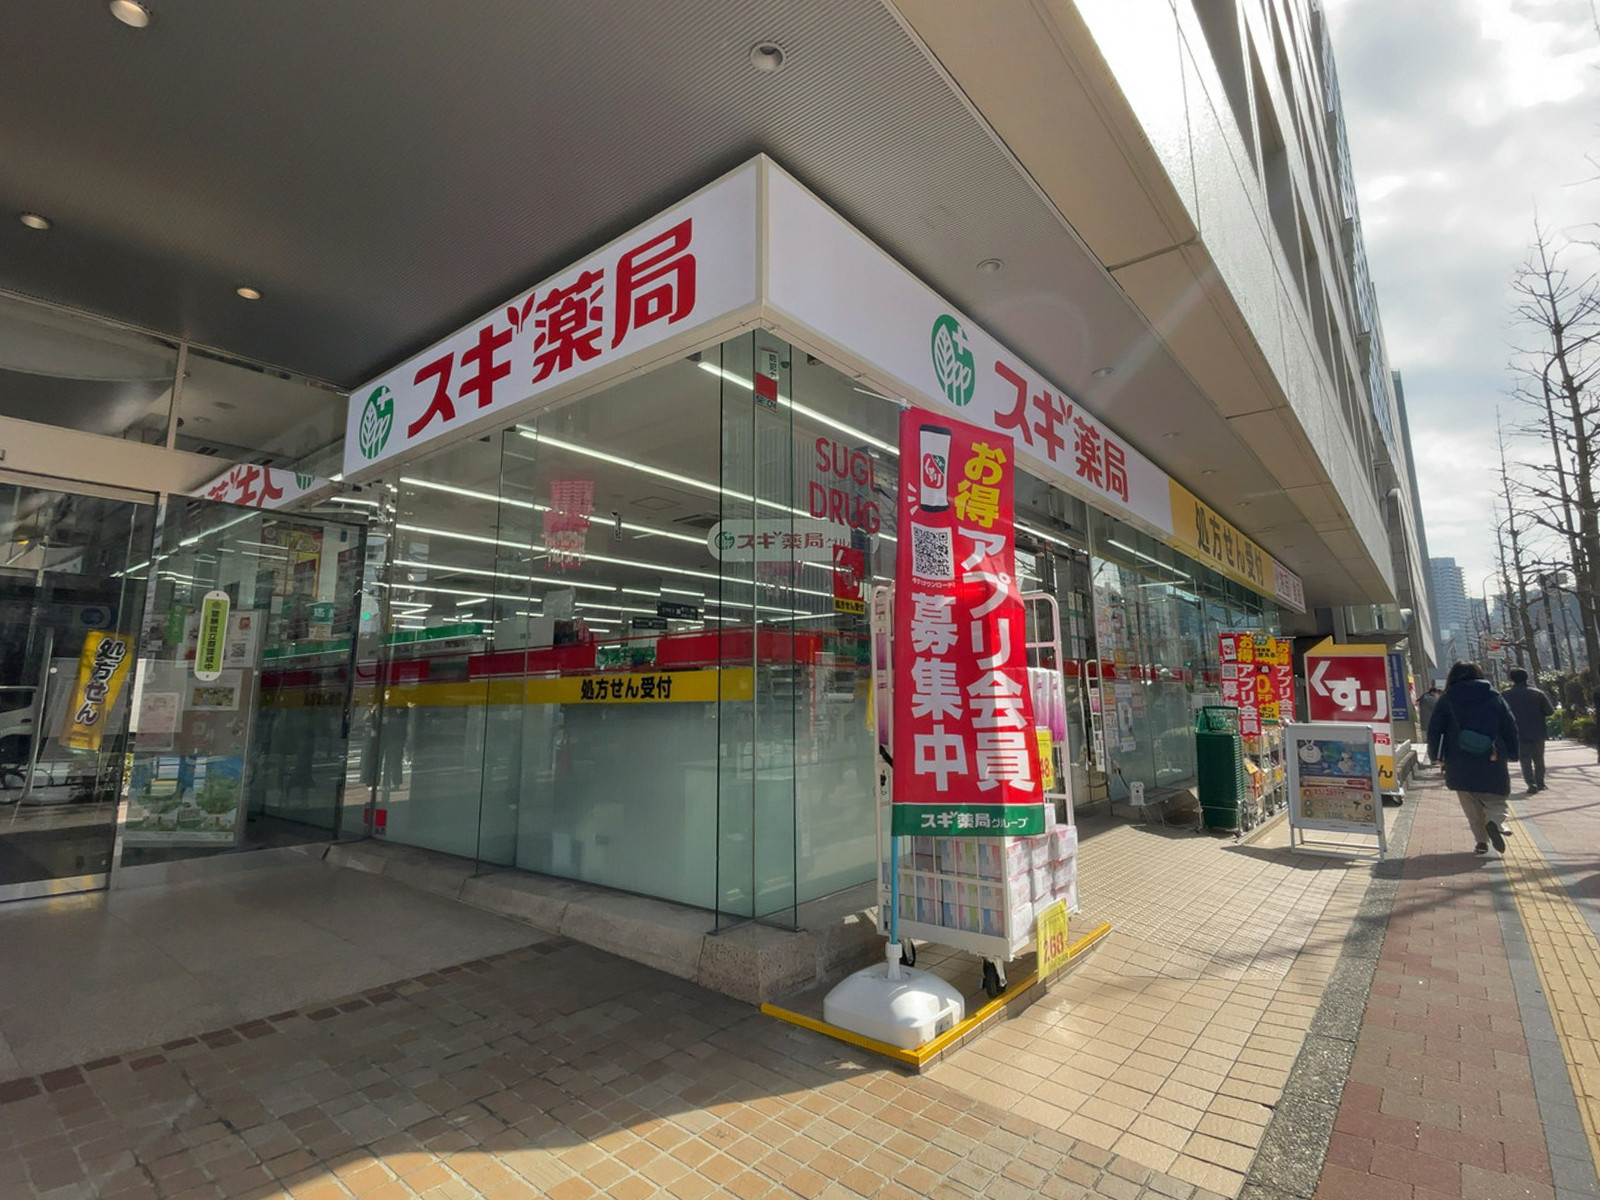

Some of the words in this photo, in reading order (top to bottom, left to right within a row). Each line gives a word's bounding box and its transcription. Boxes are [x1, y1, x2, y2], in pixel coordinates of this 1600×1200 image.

[407, 217, 697, 438] スギ薬局
[815, 436, 879, 492] SUGI
[993, 360, 1129, 503] スギ薬局
[809, 482, 881, 535] DRUG
[1195, 501, 1264, 587] 処方せん受付
[75, 638, 127, 725] 処方せん
[581, 676, 672, 700] 処方せん受付
[910, 591, 969, 792] 募集中
[1310, 660, 1390, 720] くすり
[921, 811, 1028, 829] スギ薬局グループ
